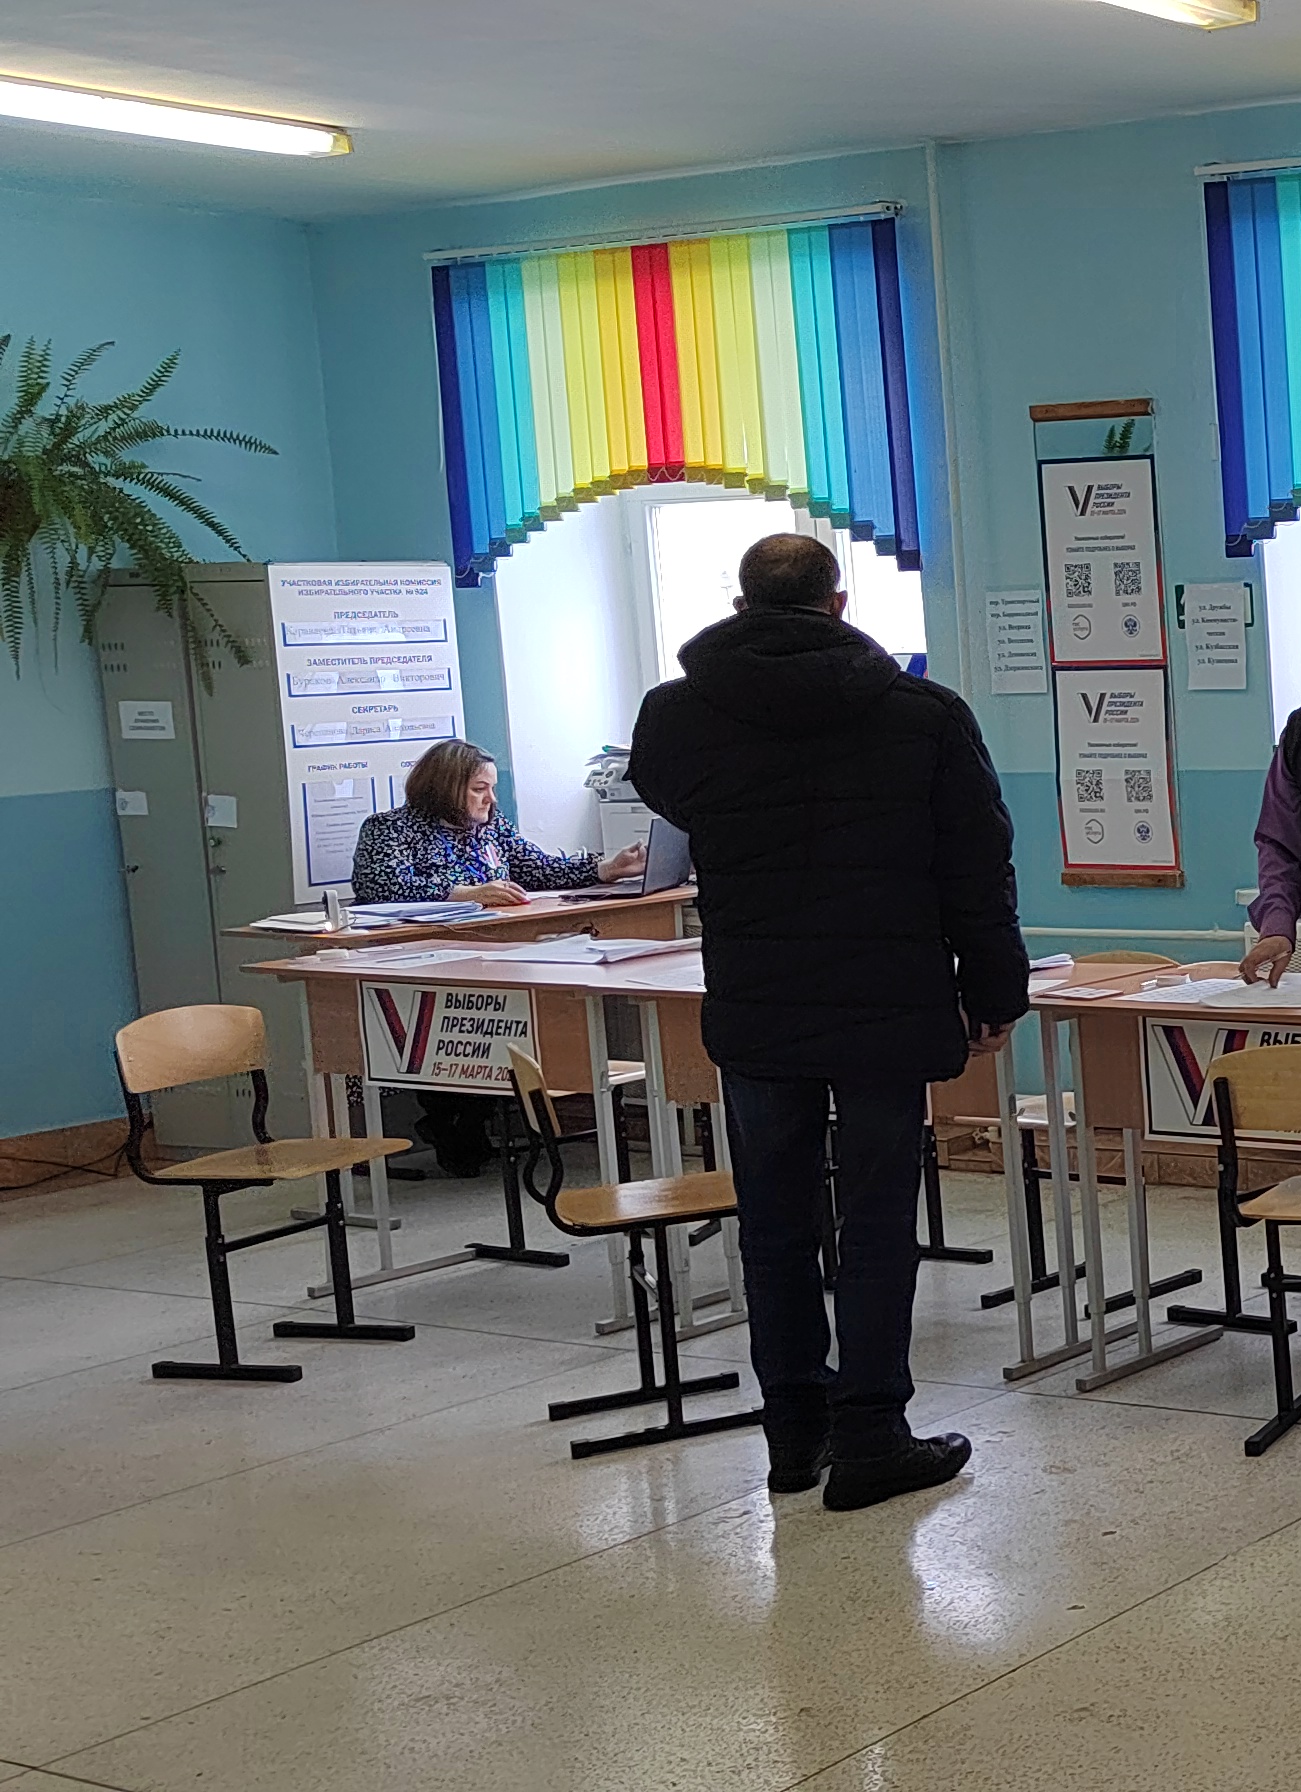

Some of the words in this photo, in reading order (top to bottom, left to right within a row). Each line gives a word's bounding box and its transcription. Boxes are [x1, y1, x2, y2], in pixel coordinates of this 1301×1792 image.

[334, 611, 399, 619] ПРЕДСЕДАТЕЛЬ
[307, 656, 368, 666] ЗАМЕСТИТЕЛЬ
[369, 655, 433, 665] ПРЕДСЕДАТЕЛЯ
[353, 705, 399, 714] СЕКРЕТАРЬ
[444, 992, 507, 1012] ВЫБОРЫ
[440, 1016, 528, 1039] ПРЕЗИДЕНТА
[435, 1039, 492, 1059] РОССИИ
[459, 1064, 493, 1081] МАРТА
